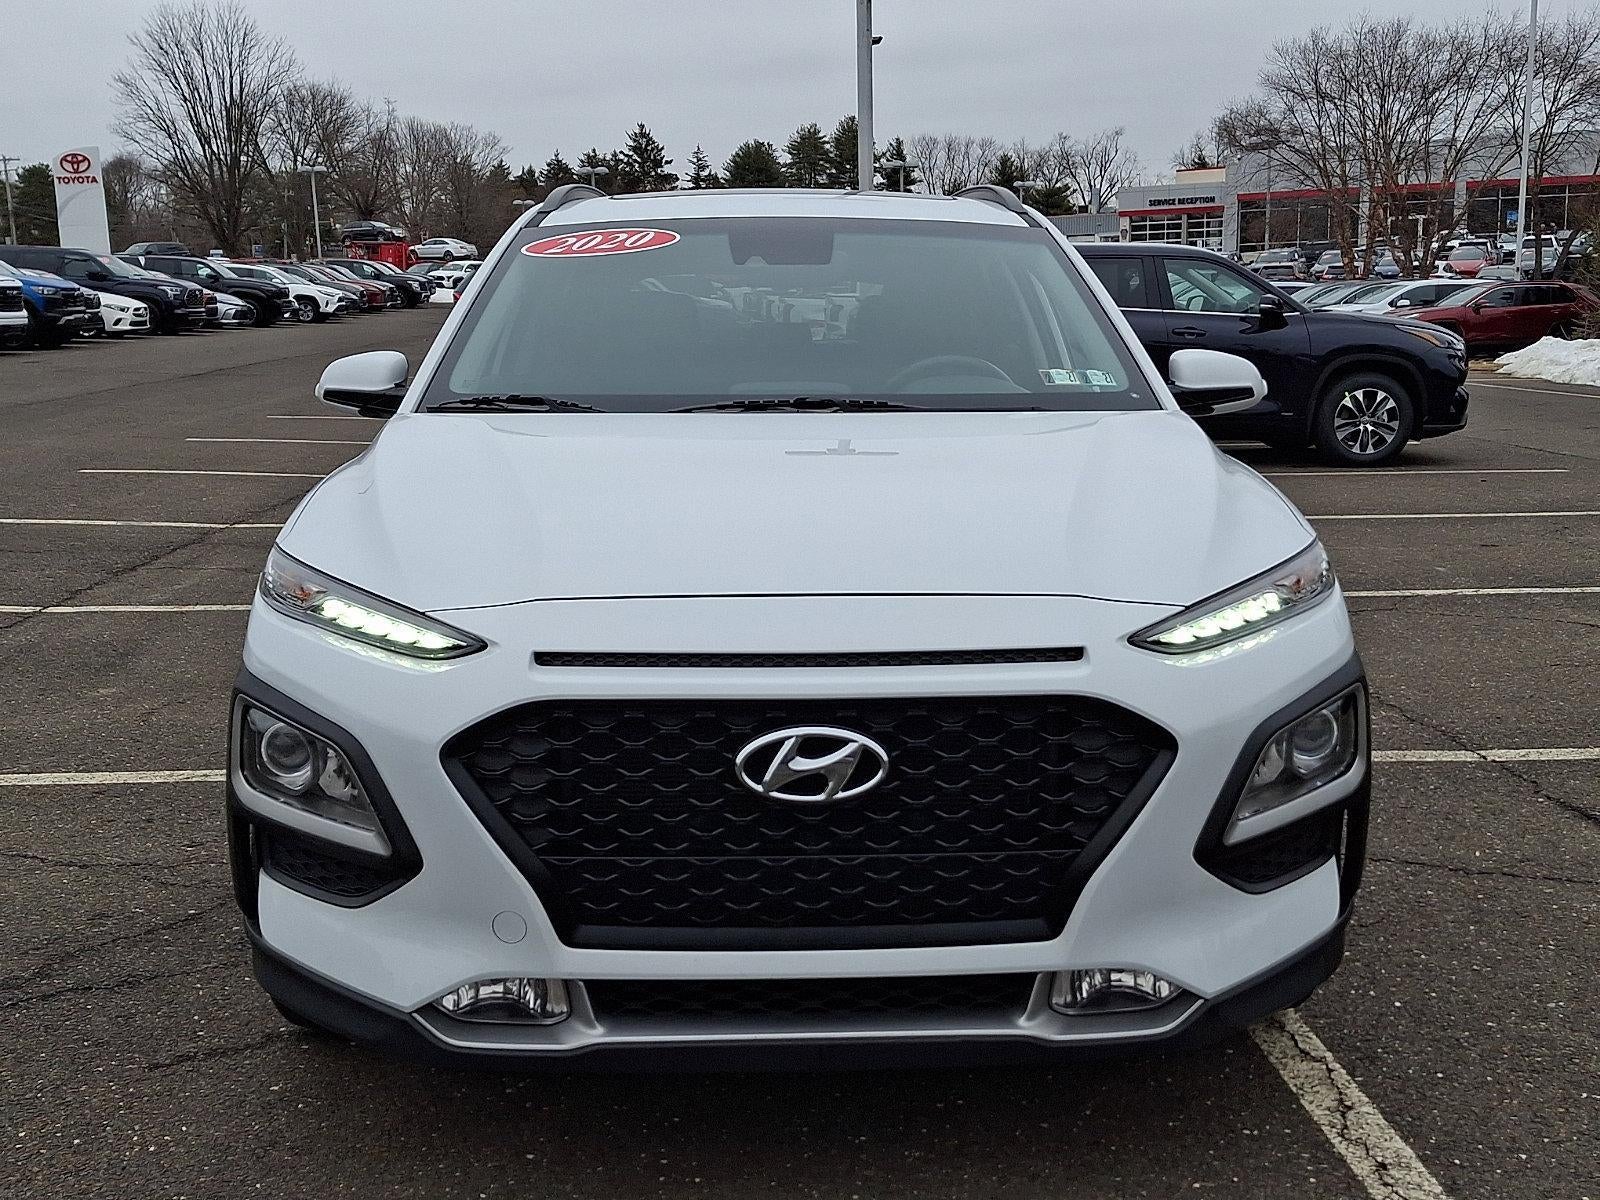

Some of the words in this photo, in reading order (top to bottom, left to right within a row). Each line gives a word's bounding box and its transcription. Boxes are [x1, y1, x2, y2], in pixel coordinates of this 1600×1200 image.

[56, 176, 98, 184] TOYOTA
[1148, 197, 1177, 206] SERVICE
[1177, 195, 1216, 205] RECEPTION
[542, 231, 656, 254] 2020
